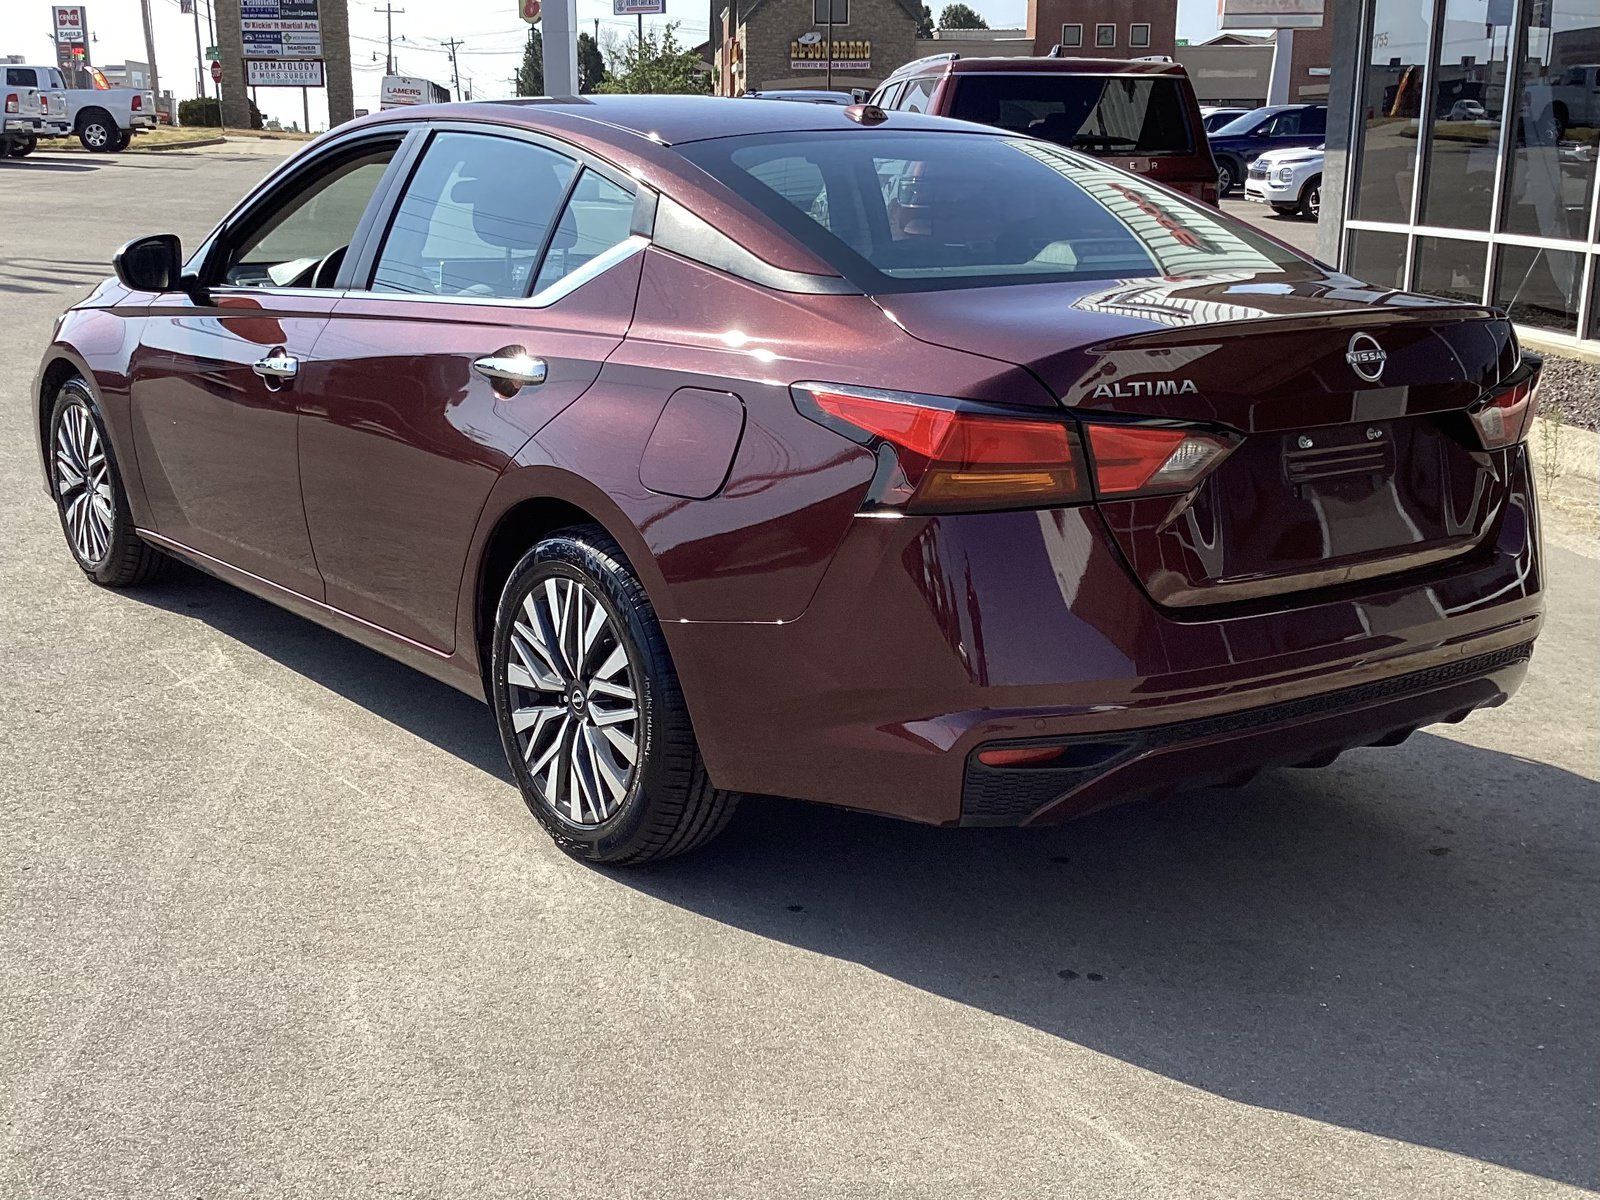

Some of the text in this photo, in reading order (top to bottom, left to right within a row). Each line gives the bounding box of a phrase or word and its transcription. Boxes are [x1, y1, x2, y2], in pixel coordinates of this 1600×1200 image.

[253, 62, 315, 71] DERMATOLOGY
[387, 87, 421, 95] LAMERS
[1346, 350, 1386, 364] NISSAN
[1092, 379, 1199, 399] ALTIMA
